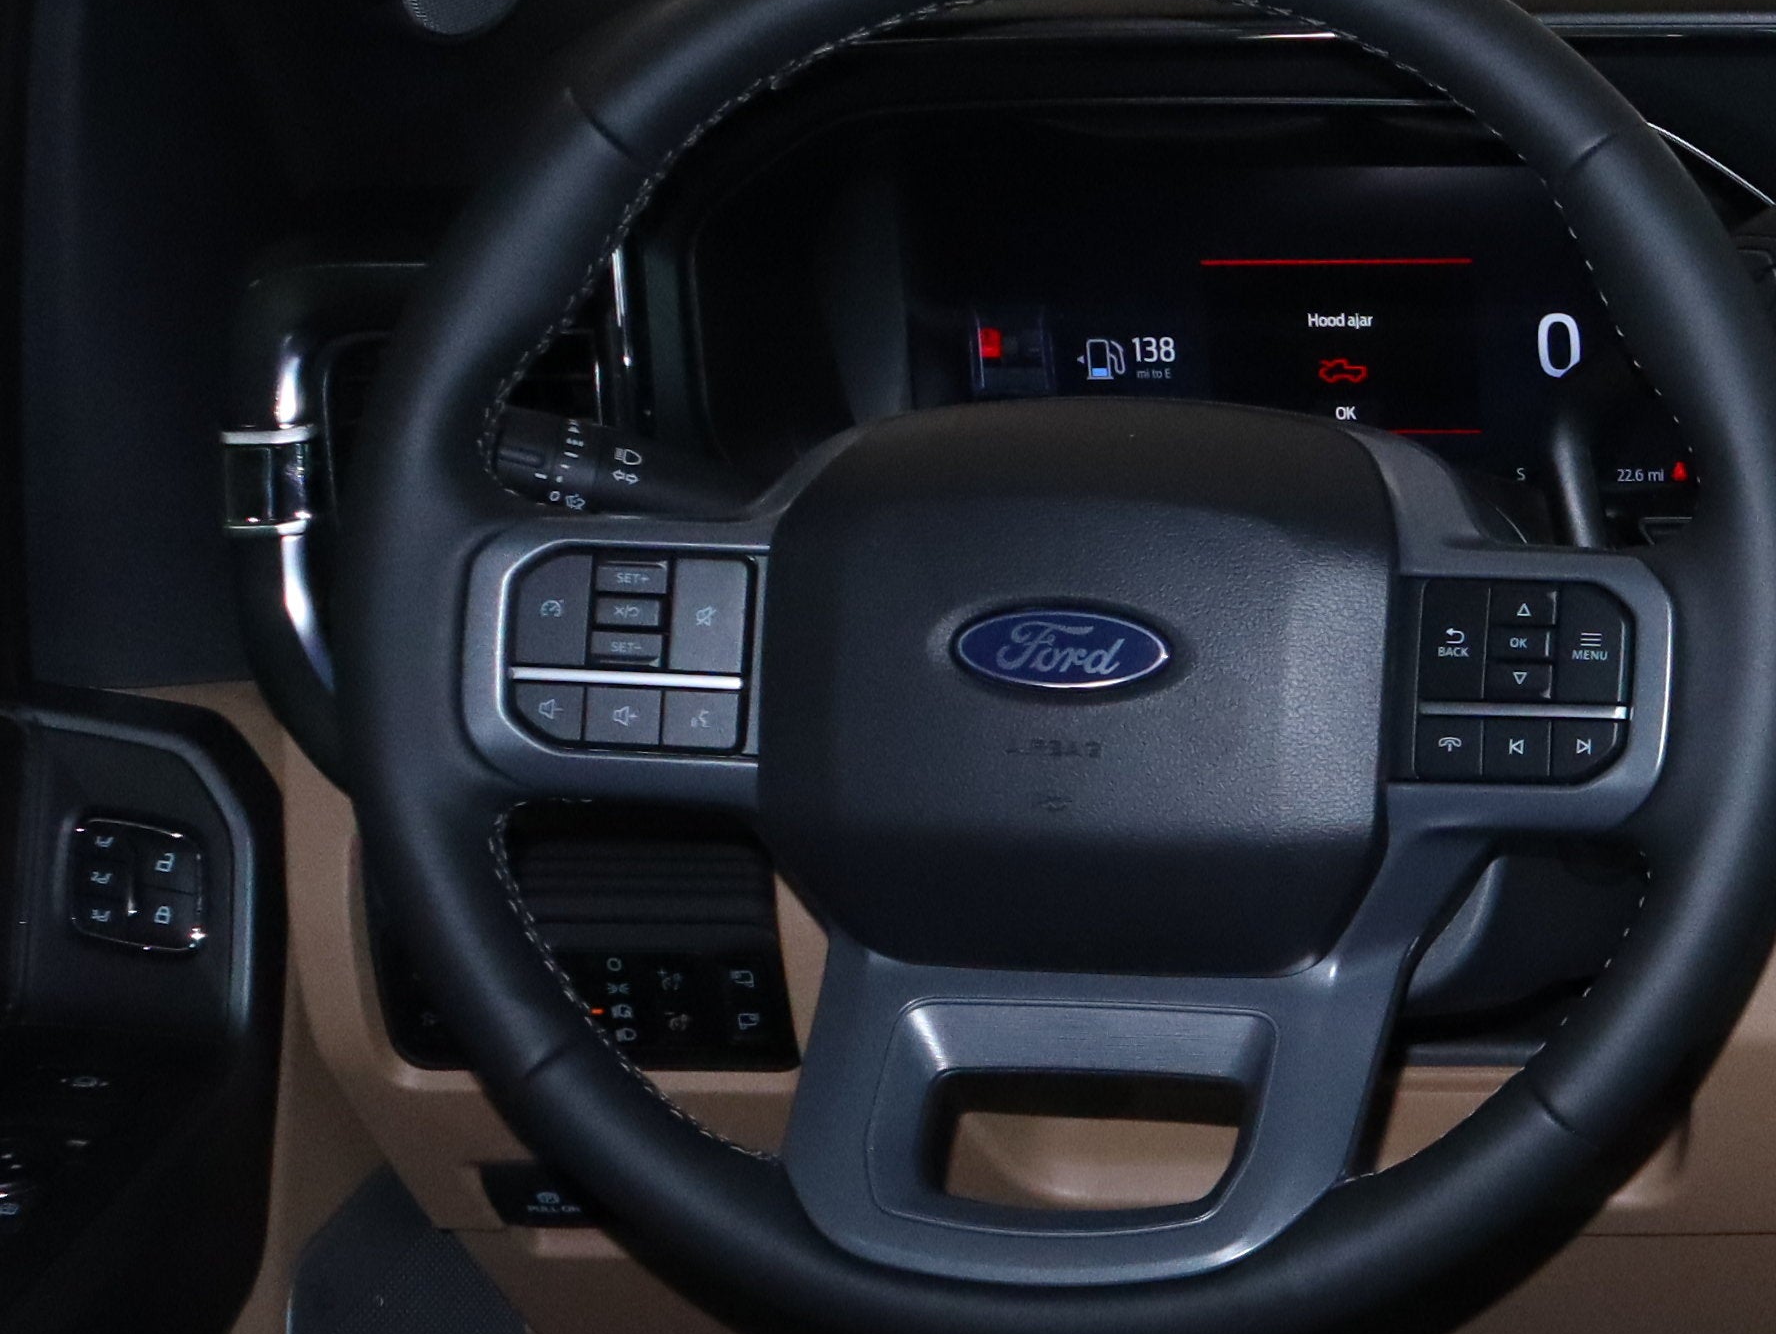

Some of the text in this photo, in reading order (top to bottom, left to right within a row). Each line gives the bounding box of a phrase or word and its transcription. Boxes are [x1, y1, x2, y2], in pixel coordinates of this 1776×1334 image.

[1307, 312, 1373, 330] Hood ajar
[1131, 336, 1176, 363] 138
[1537, 312, 1581, 378] 0
[1136, 368, 1172, 379] mi to E
[1335, 406, 1357, 421] OK
[1516, 467, 1526, 481] S
[1617, 468, 1665, 482] 22.6 mi
[997, 620, 1125, 676] Ford
[1509, 637, 1528, 649] OK
[1437, 646, 1470, 658] BACK
[1571, 649, 1608, 661] MENU
